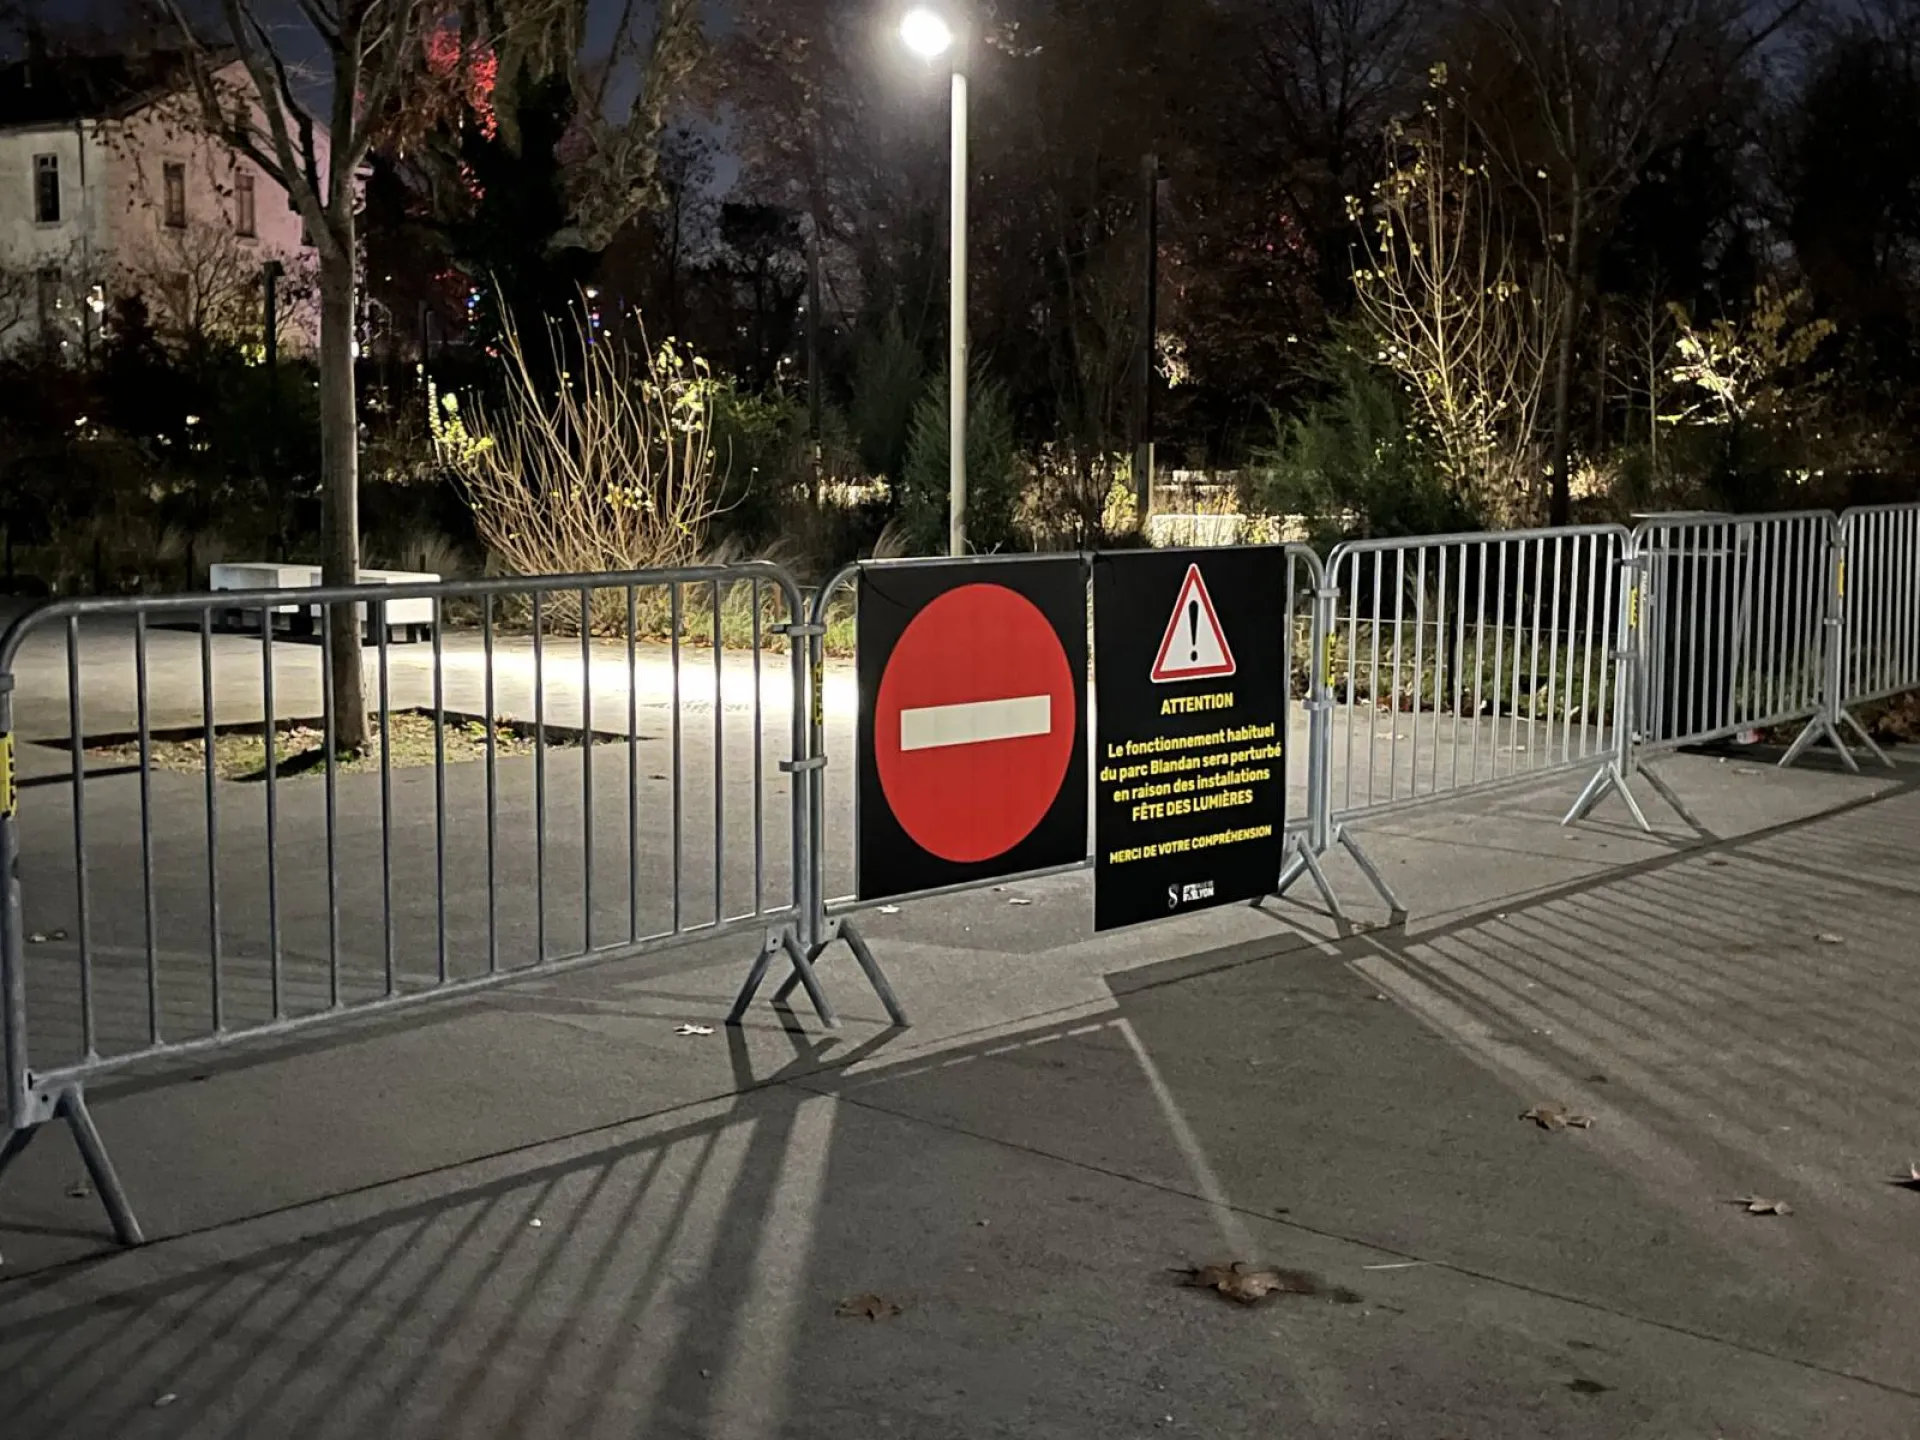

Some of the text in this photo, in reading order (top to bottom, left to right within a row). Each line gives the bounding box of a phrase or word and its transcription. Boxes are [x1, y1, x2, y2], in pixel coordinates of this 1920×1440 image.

[1161, 692, 1234, 715] ATTENTION
[1108, 723, 1275, 758] Le fonctionnement habituel
[1100, 742, 1281, 783] du parc Blandan sera perturbé
[1113, 767, 1270, 802] en raison des installations
[1132, 789, 1253, 822] FÊTE DES LUMIÈRES
[1110, 824, 1272, 864] MERCI DE VOTRE COMPRÉHENSION
